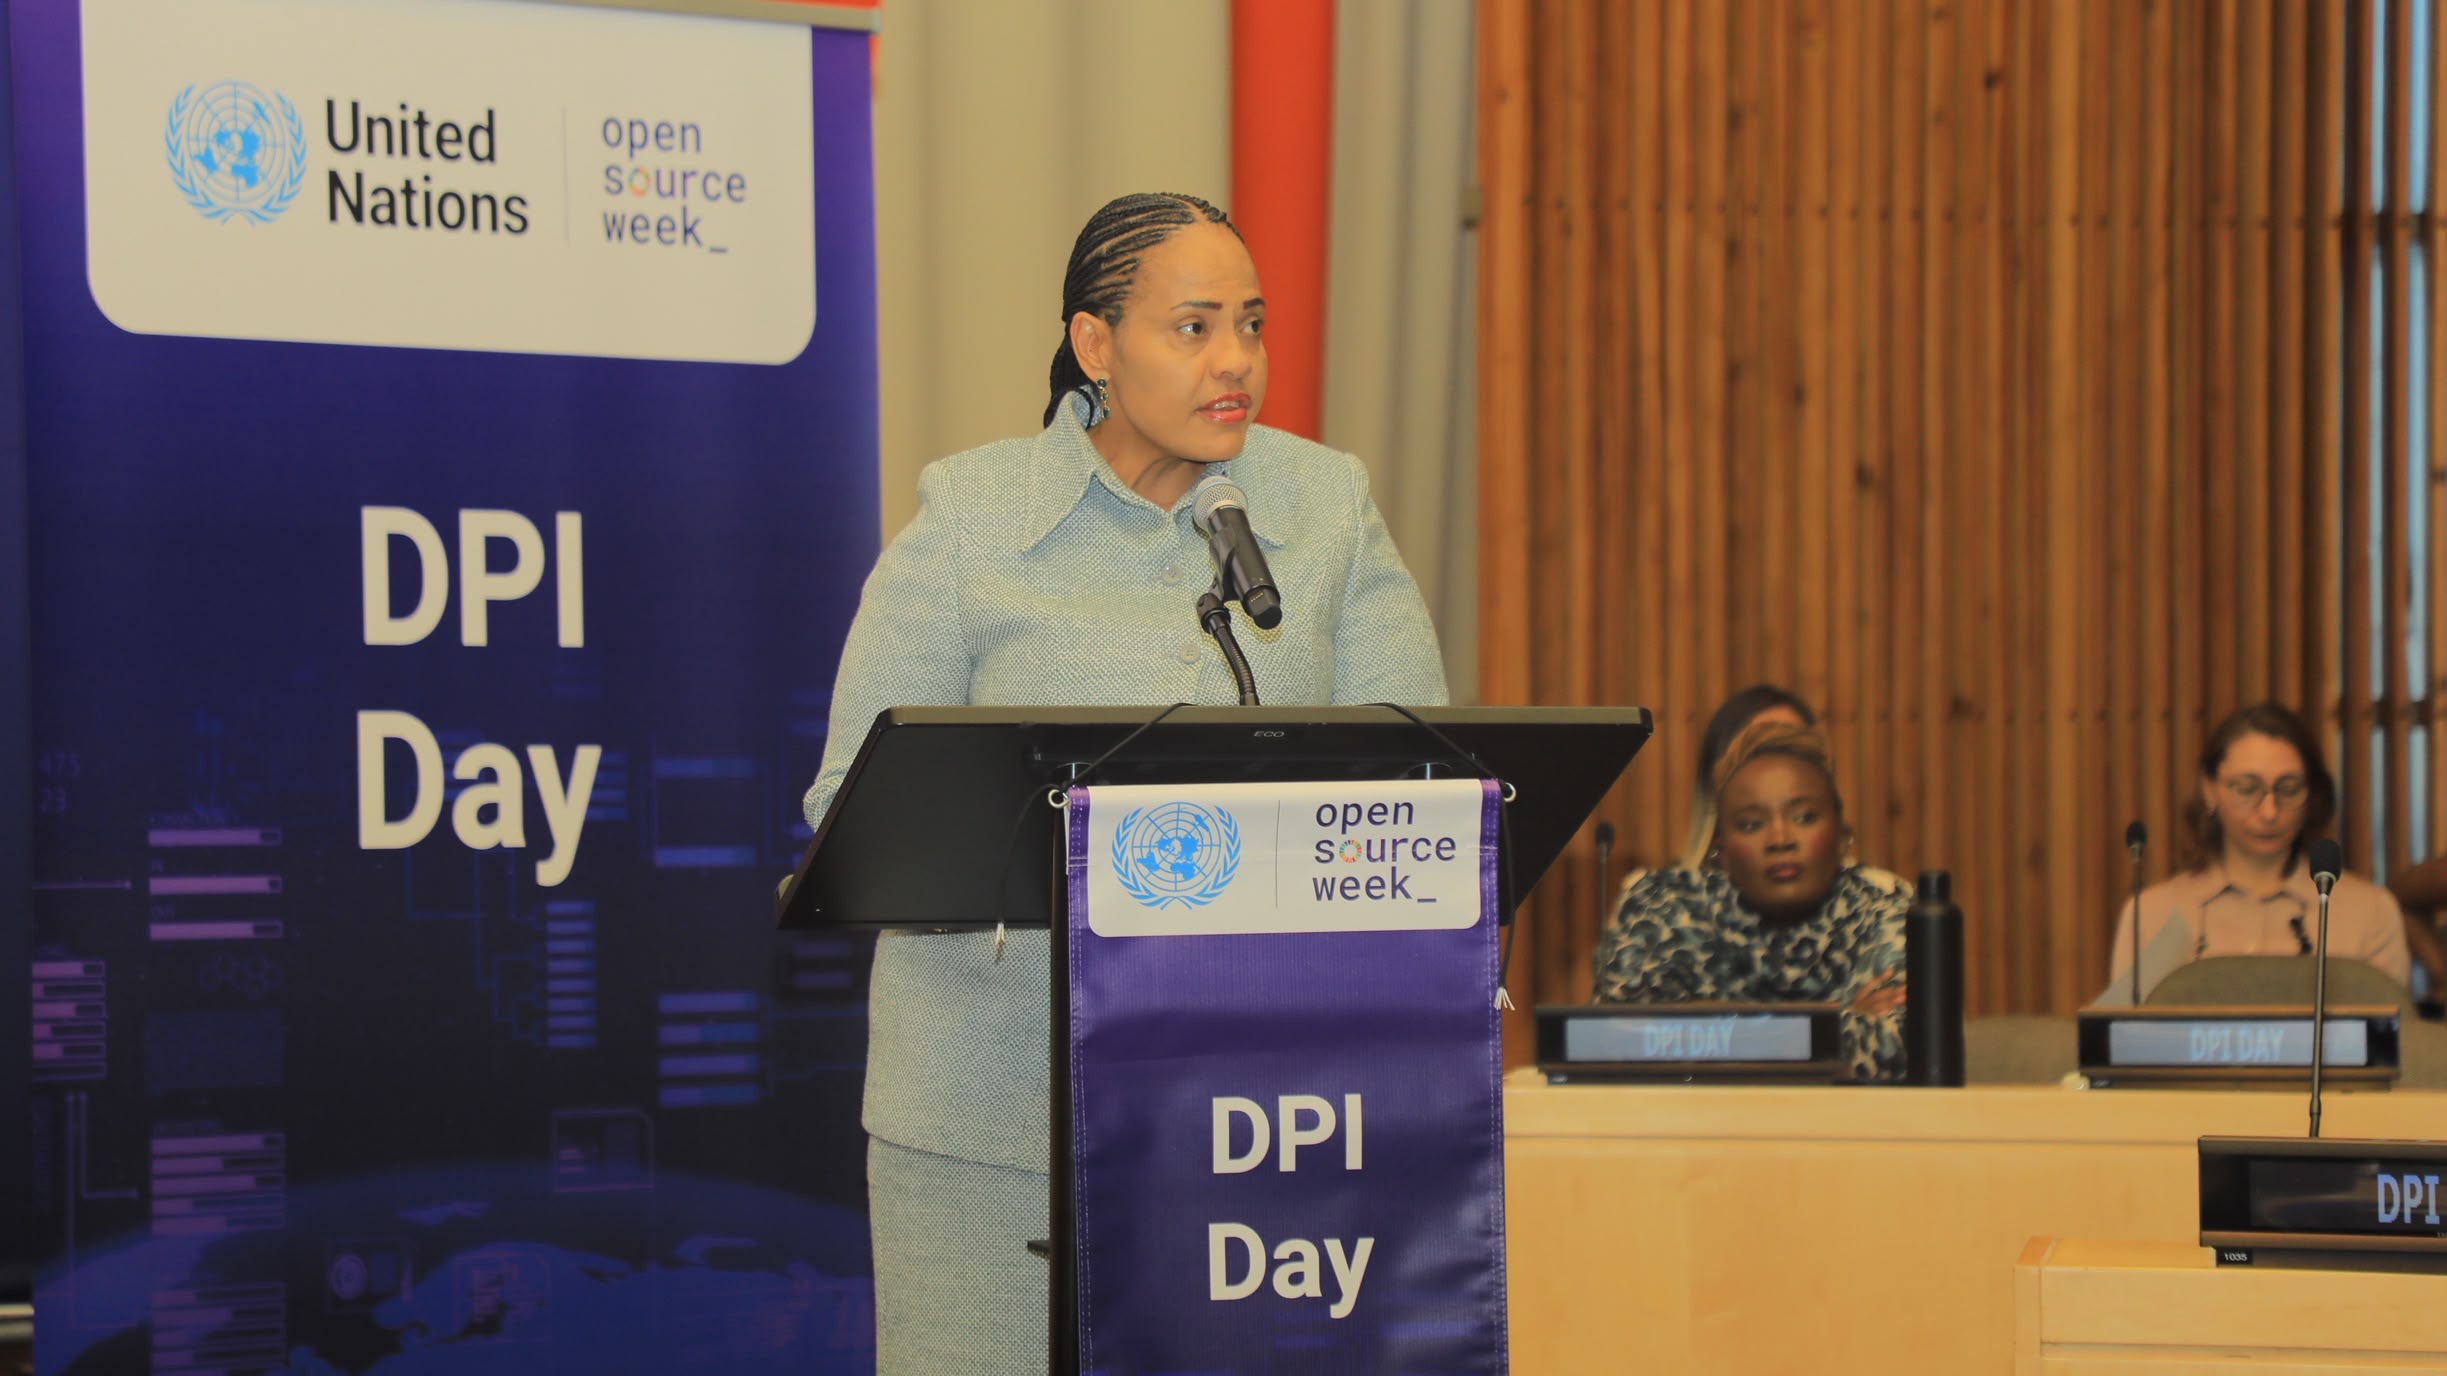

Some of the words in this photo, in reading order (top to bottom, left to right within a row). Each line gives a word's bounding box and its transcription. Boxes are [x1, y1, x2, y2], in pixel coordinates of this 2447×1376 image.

[326, 97, 496, 164] United
[602, 117, 702, 158] open
[328, 170, 529, 235] Nations
[604, 165, 746, 203] source
[603, 206, 729, 254] week_
[361, 505, 585, 649] DPI
[1254, 730, 1285, 738] ECO
[357, 710, 602, 887] Day
[1315, 802, 1414, 835] open
[1314, 837, 1456, 864] source
[1312, 866, 1437, 903] week_
[1643, 1023, 1684, 1057] DPI
[1690, 1023, 1735, 1057] DAY
[2191, 1026, 2232, 1061] DPI
[2237, 1026, 2286, 1062] DAY
[1212, 1093, 1363, 1174] DPI
[2377, 1173, 2440, 1225] DPI
[1208, 1222, 1375, 1320] Day
